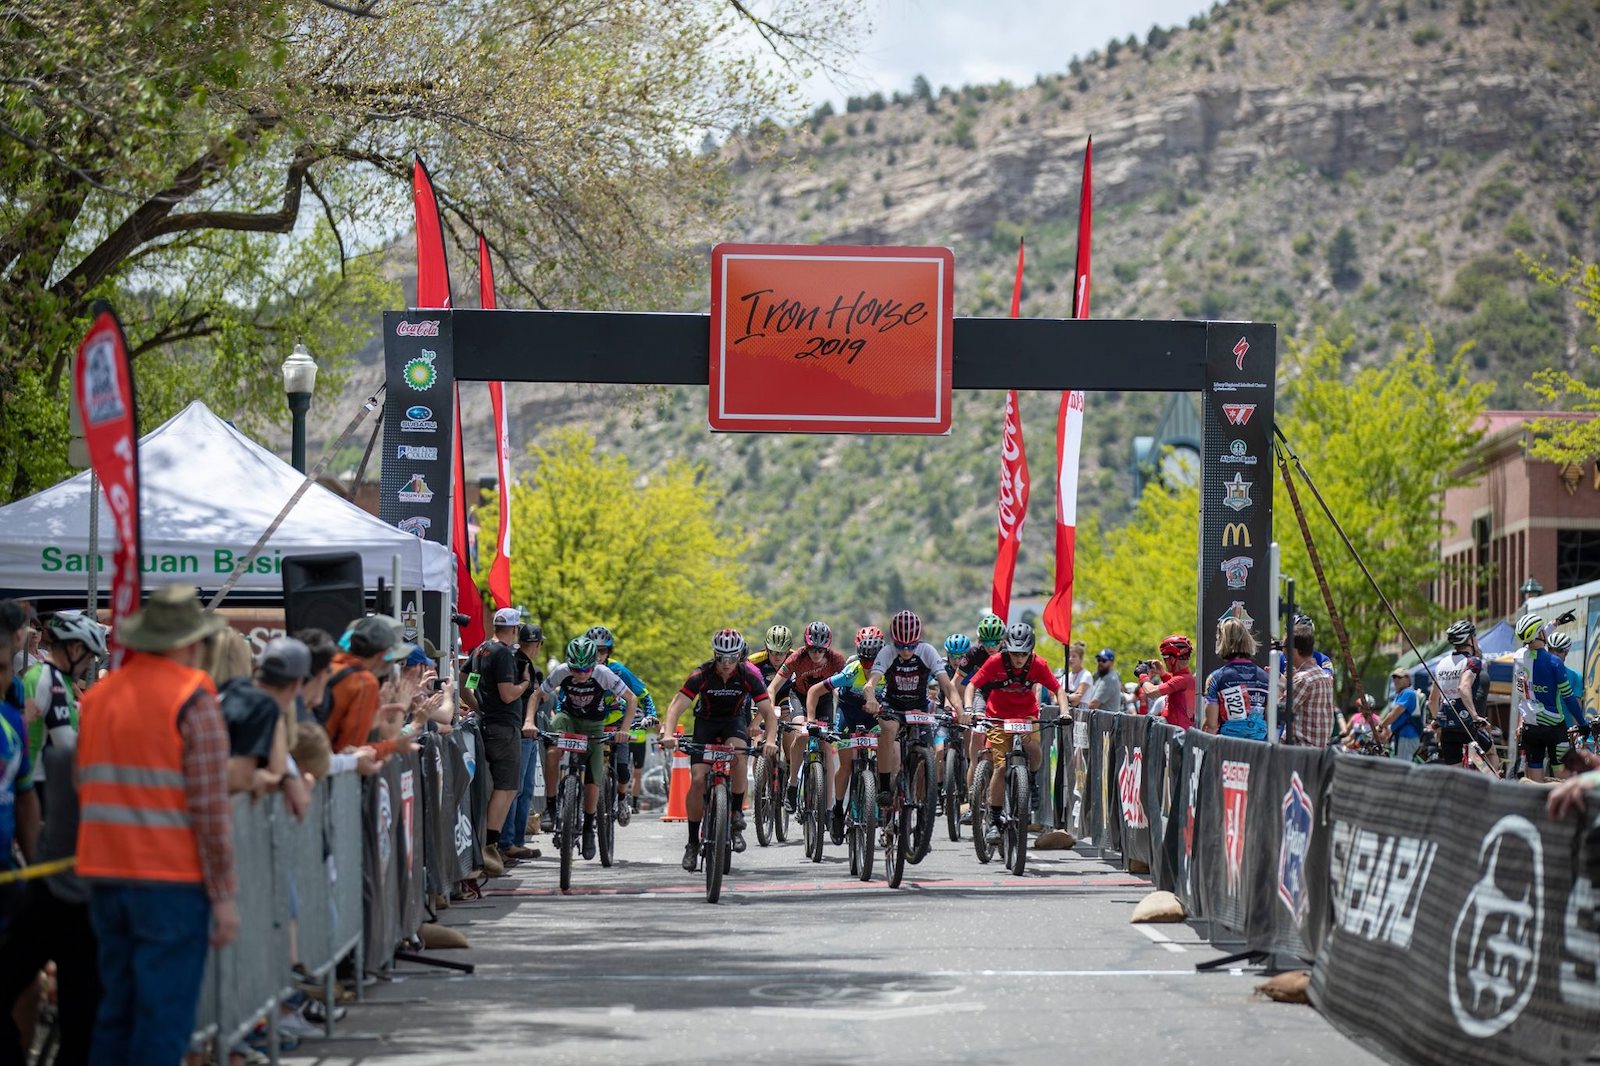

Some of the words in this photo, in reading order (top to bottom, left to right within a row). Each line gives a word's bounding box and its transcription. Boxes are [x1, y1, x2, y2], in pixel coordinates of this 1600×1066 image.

[734, 289, 819, 344] Iron
[825, 291, 928, 334] Horse
[422, 349, 436, 360] bp
[795, 337, 867, 364] 2019
[42, 547, 103, 572] San
[138, 551, 198, 573] uan
